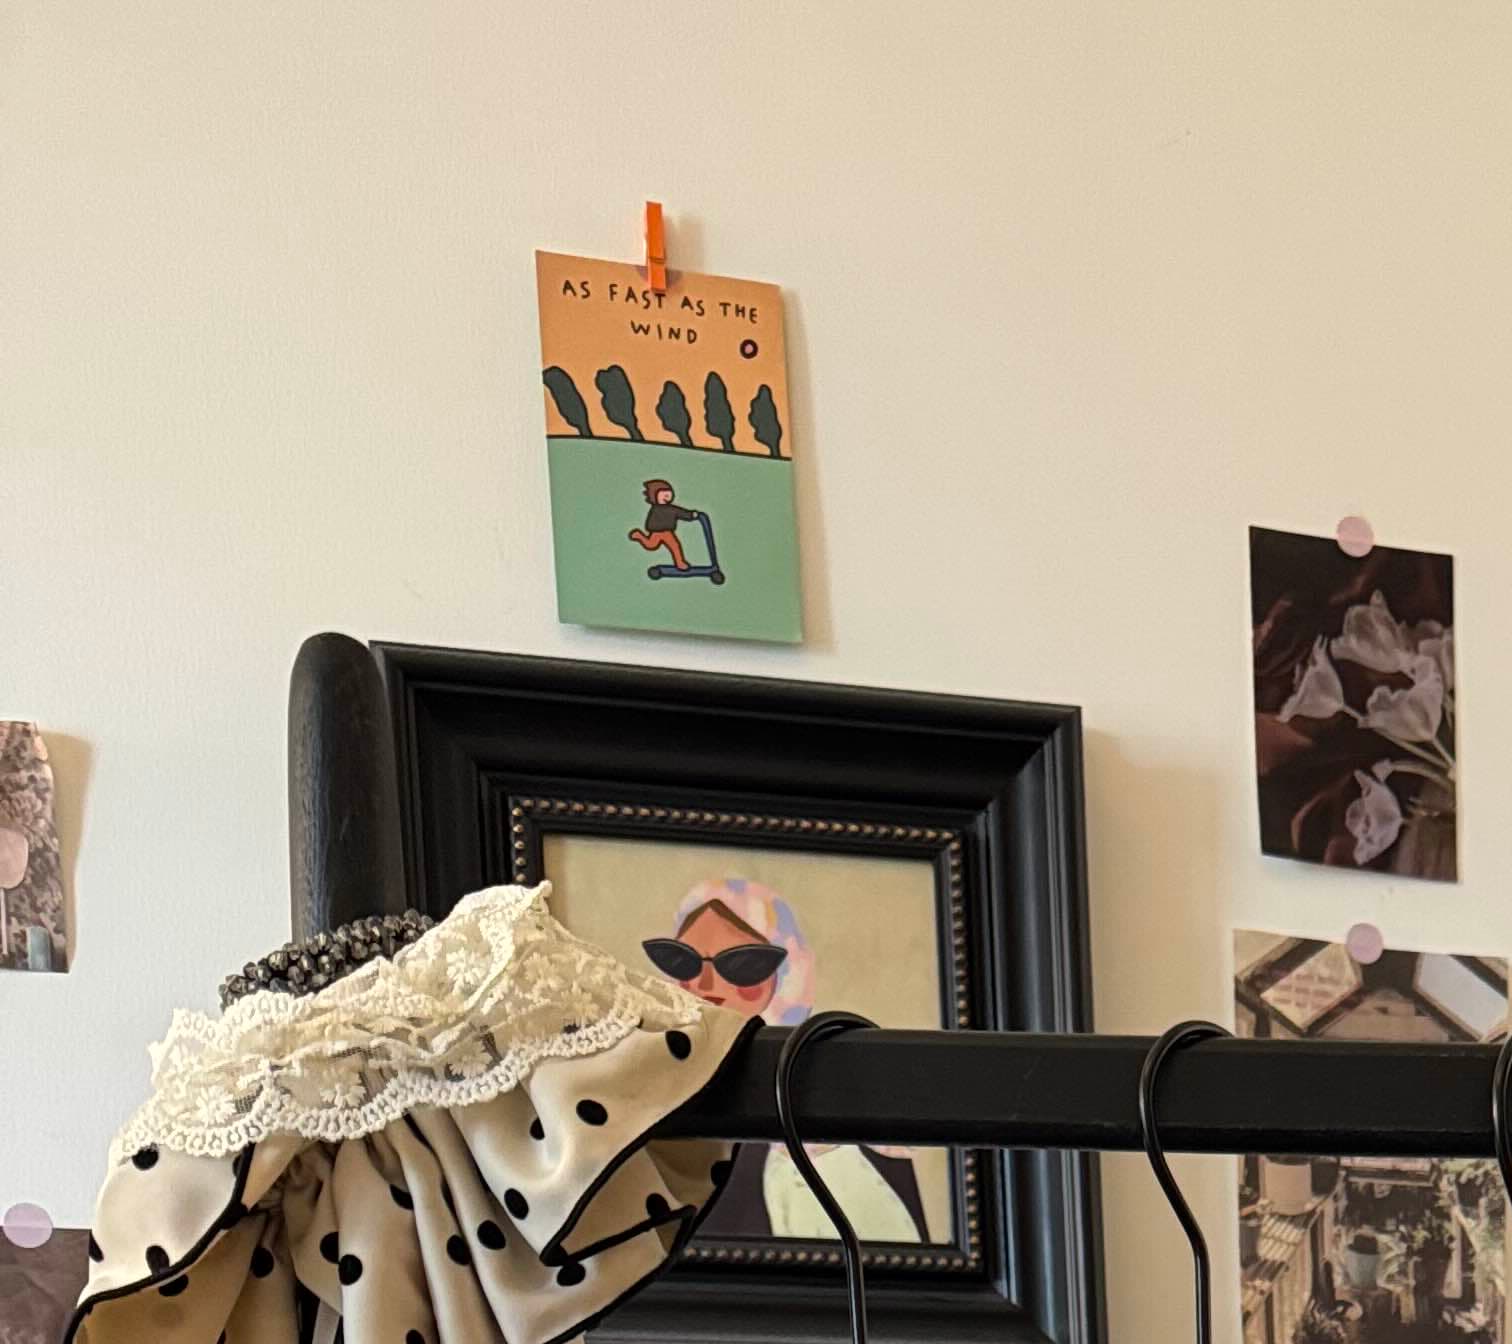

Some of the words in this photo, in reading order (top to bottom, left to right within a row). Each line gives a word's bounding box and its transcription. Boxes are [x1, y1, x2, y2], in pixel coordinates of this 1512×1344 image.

[562, 280, 591, 299] AS
[609, 284, 667, 310] FAST
[681, 296, 705, 317] AS
[719, 302, 758, 324] THE
[631, 320, 697, 344] WIND
